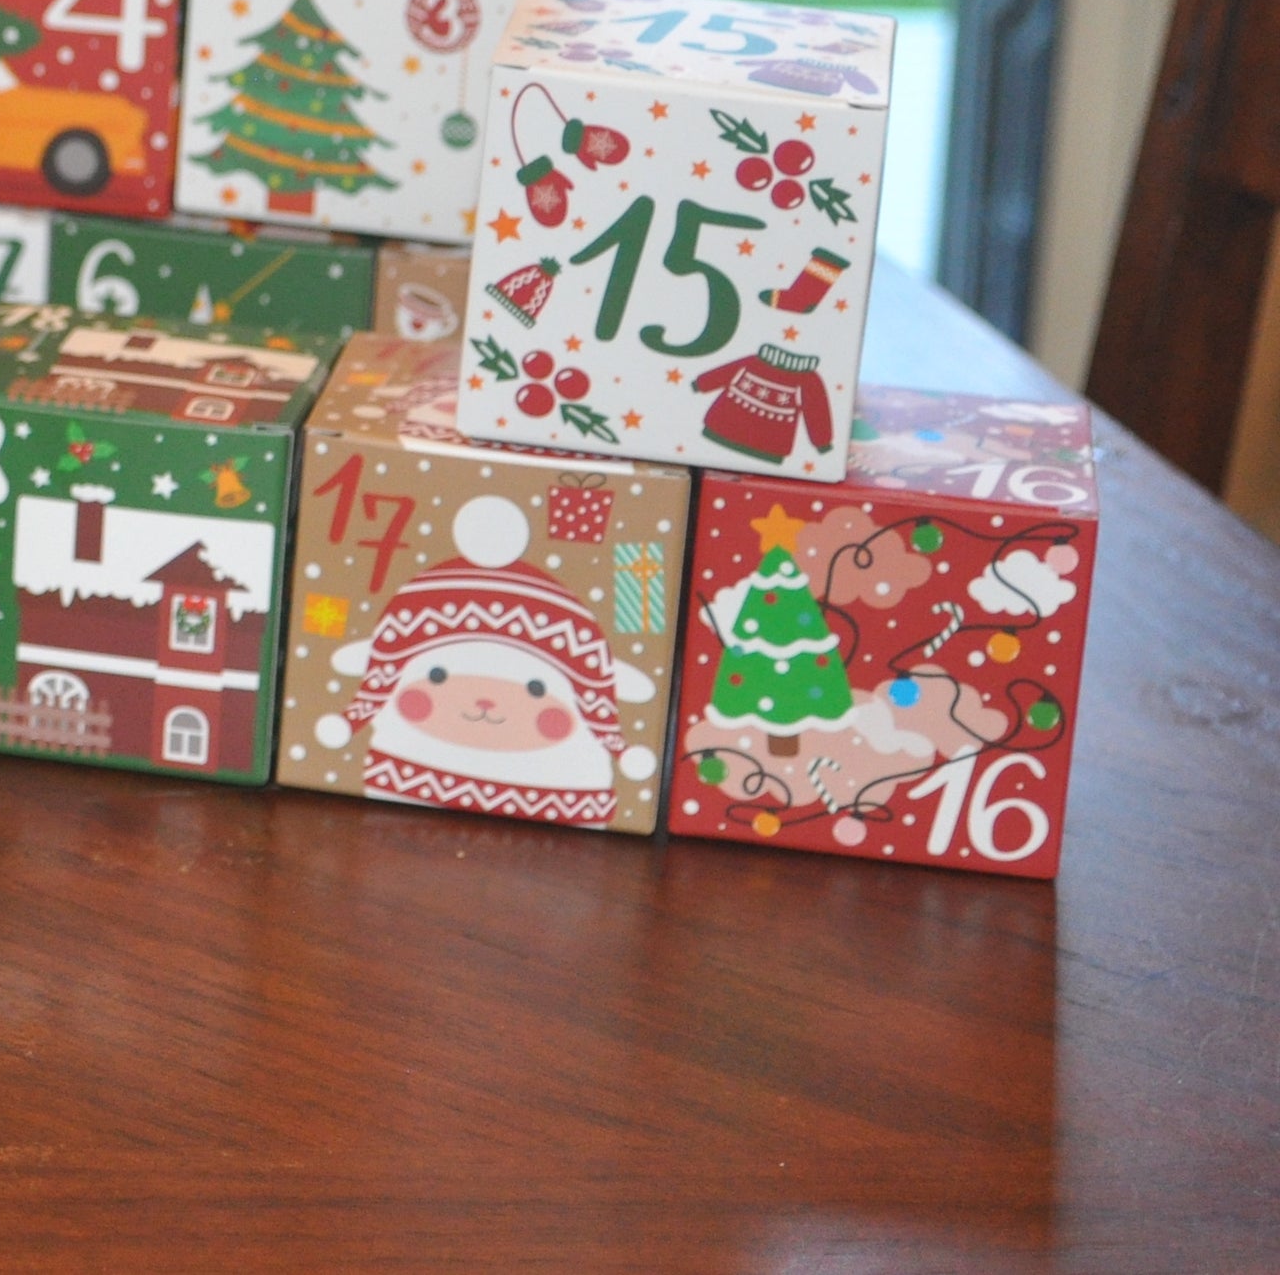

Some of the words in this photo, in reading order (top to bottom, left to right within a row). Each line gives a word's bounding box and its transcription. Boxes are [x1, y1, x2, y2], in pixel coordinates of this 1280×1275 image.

[612, 9, 780, 57] 15
[569, 195, 768, 357] 15
[314, 454, 416, 594] 17
[945, 462, 1088, 505] 16
[908, 745, 1050, 862] 16
